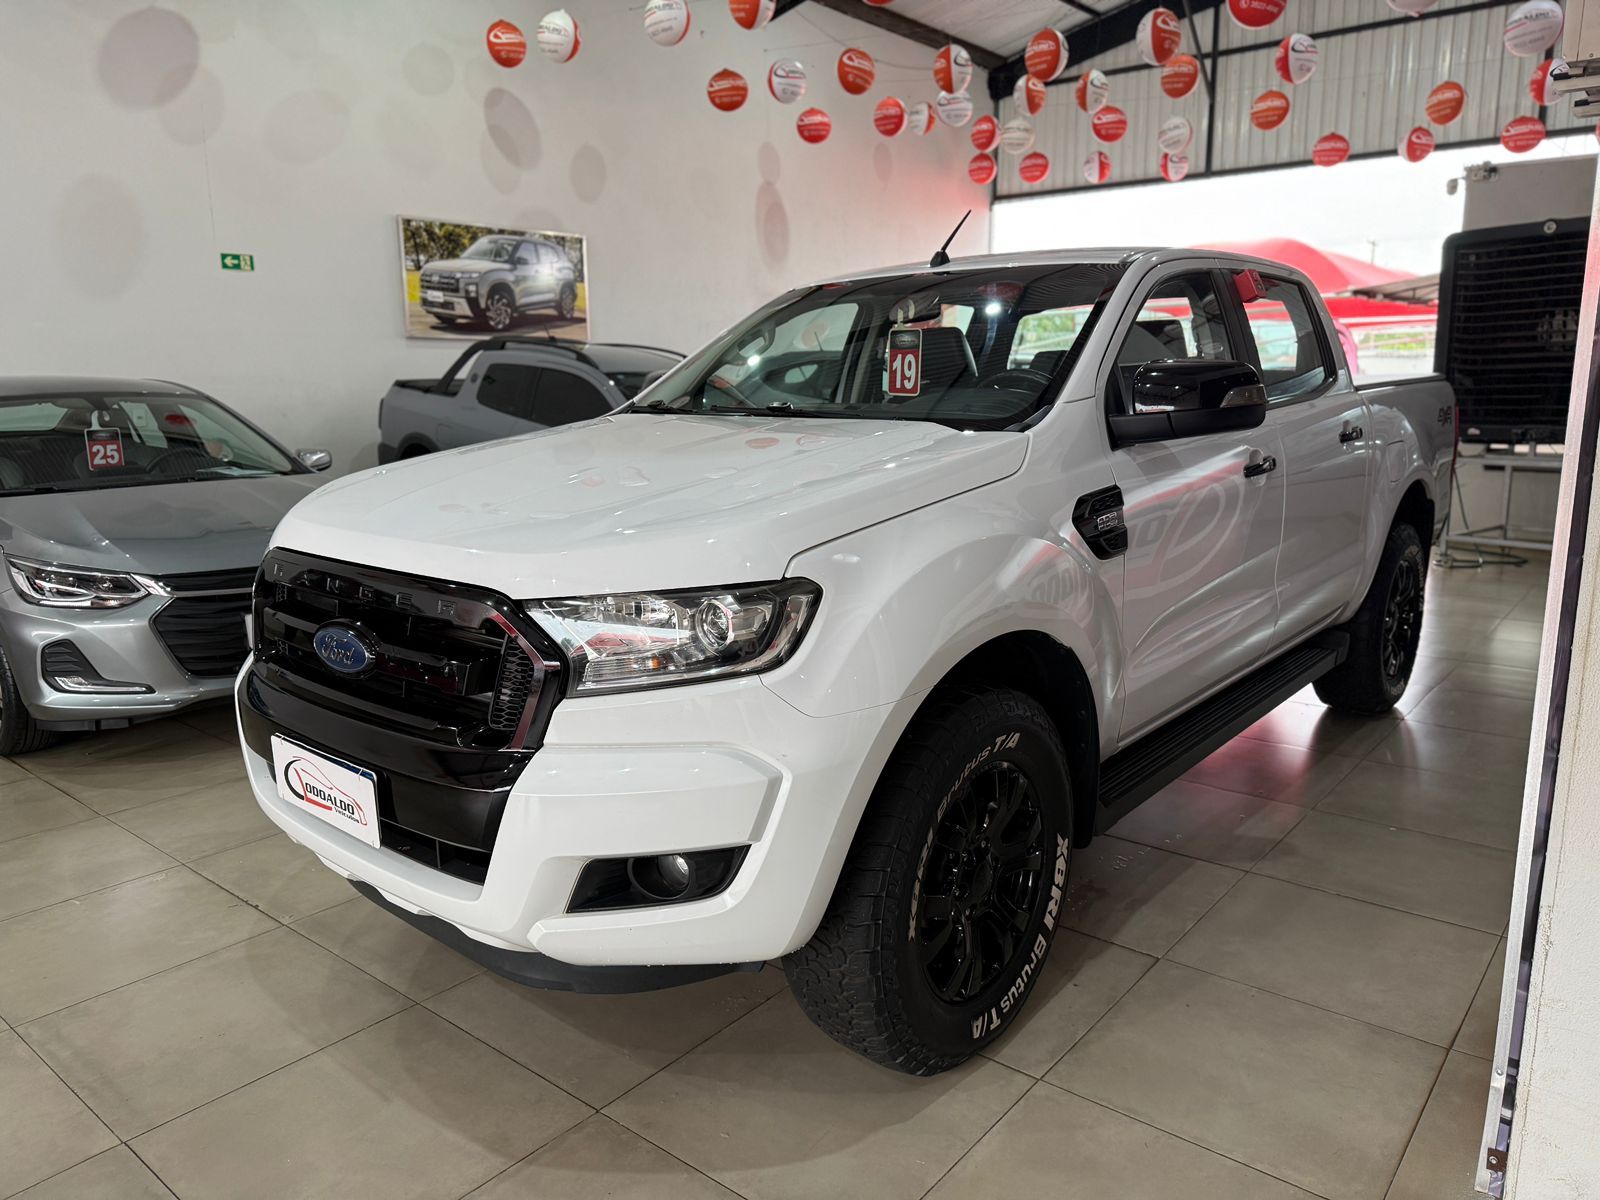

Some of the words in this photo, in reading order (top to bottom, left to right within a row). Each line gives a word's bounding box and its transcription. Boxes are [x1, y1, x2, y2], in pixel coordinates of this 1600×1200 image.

[892, 353, 917, 390] 19
[92, 444, 120, 465] 25
[321, 632, 356, 665] Ford
[992, 731, 1021, 754] T/A
[1043, 831, 1070, 931] XBRI
[1000, 932, 1048, 1014] Brutus
[970, 1009, 1001, 1040] T/A
